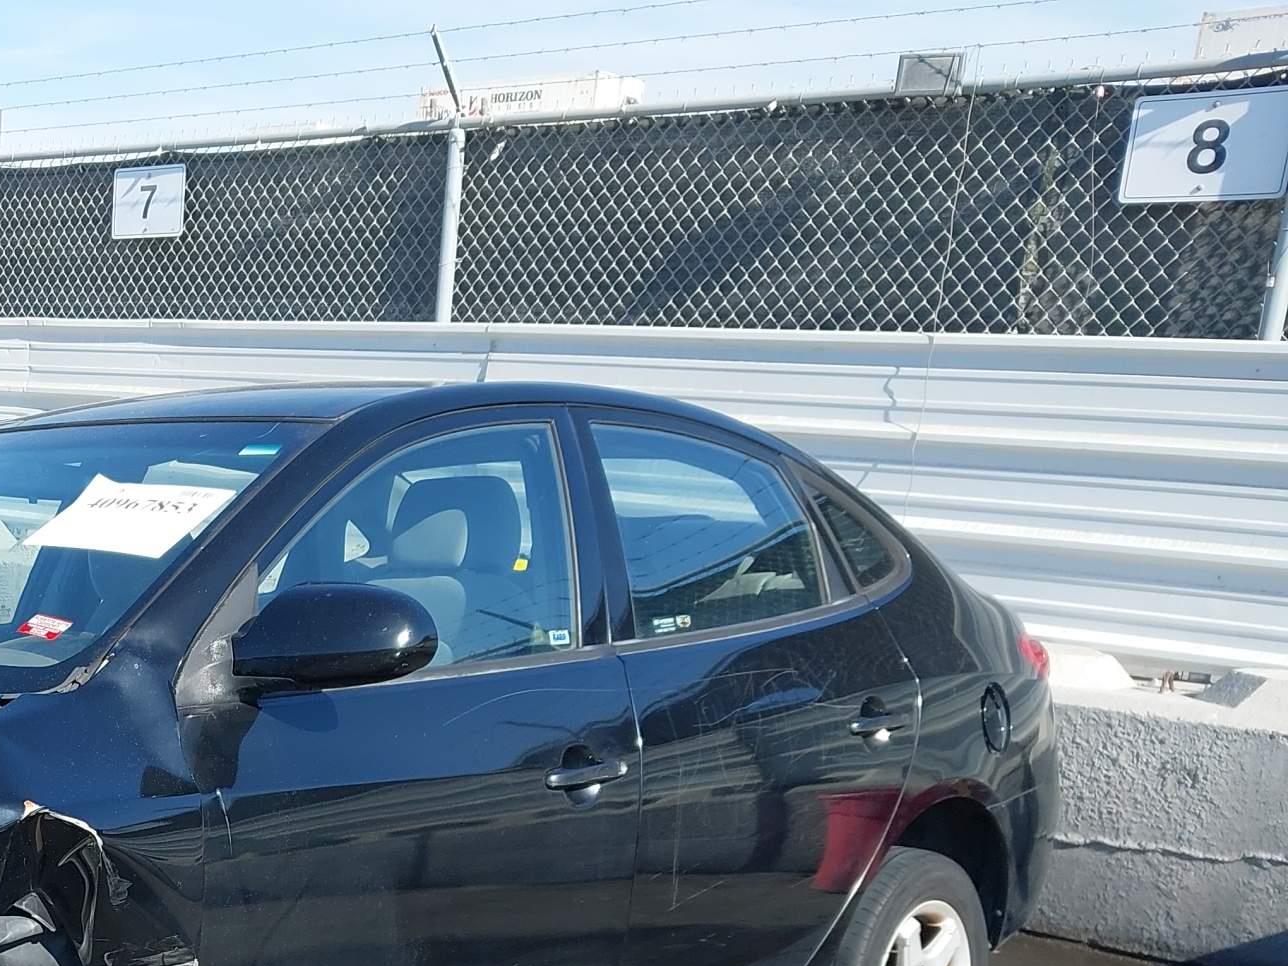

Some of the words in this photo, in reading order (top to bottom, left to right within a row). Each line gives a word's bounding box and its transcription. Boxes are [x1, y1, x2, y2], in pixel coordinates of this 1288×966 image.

[490, 90, 542, 103] HORIZON
[1186, 119, 1231, 175] 8
[139, 184, 158, 219] 7
